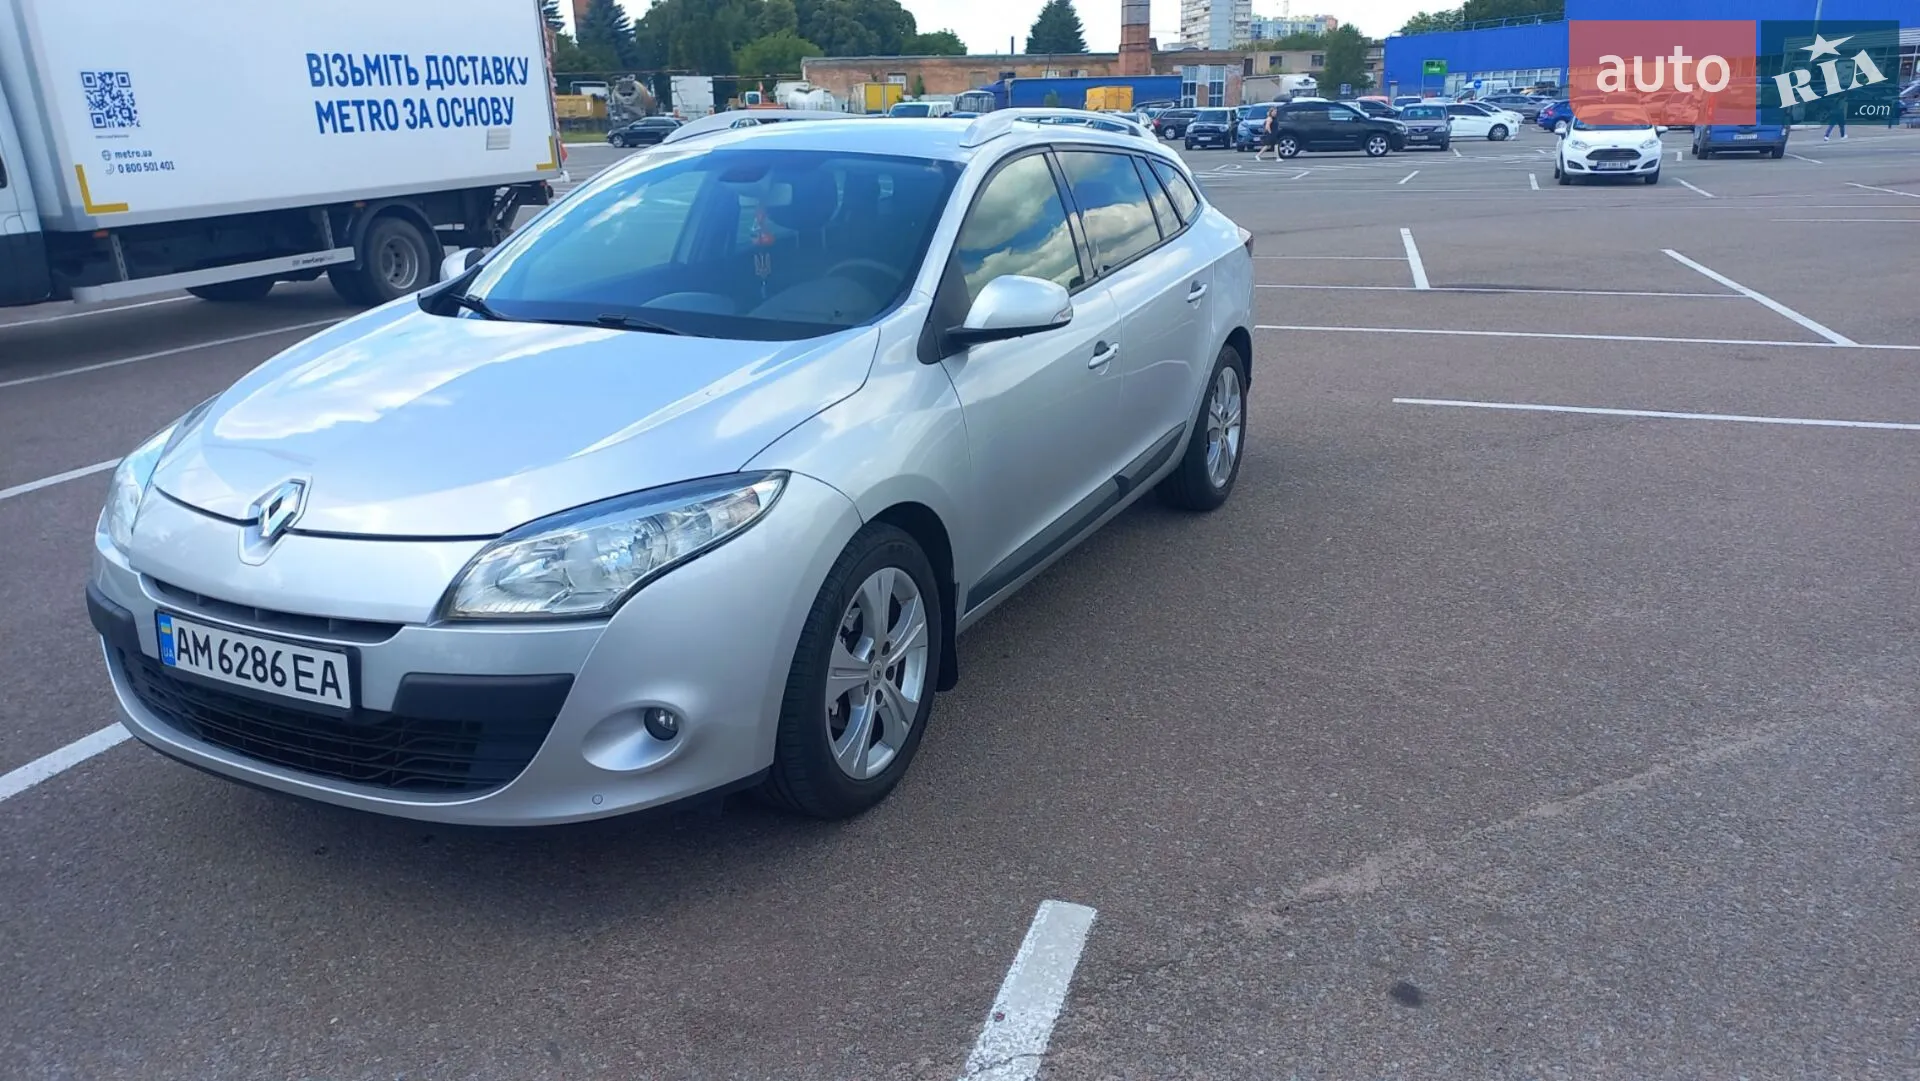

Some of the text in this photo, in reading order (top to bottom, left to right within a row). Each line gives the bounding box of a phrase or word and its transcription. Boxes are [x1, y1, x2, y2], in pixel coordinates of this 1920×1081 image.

[305, 53, 529, 90] ВІЗЬМІТЬ ДОСТАВКУ
[315, 96, 515, 134] METRO ЗА ОСНОВУ
[114, 150, 152, 159] metro.ua
[117, 161, 174, 173] 0 800 501 401
[176, 627, 343, 700] AM 6286 EA
